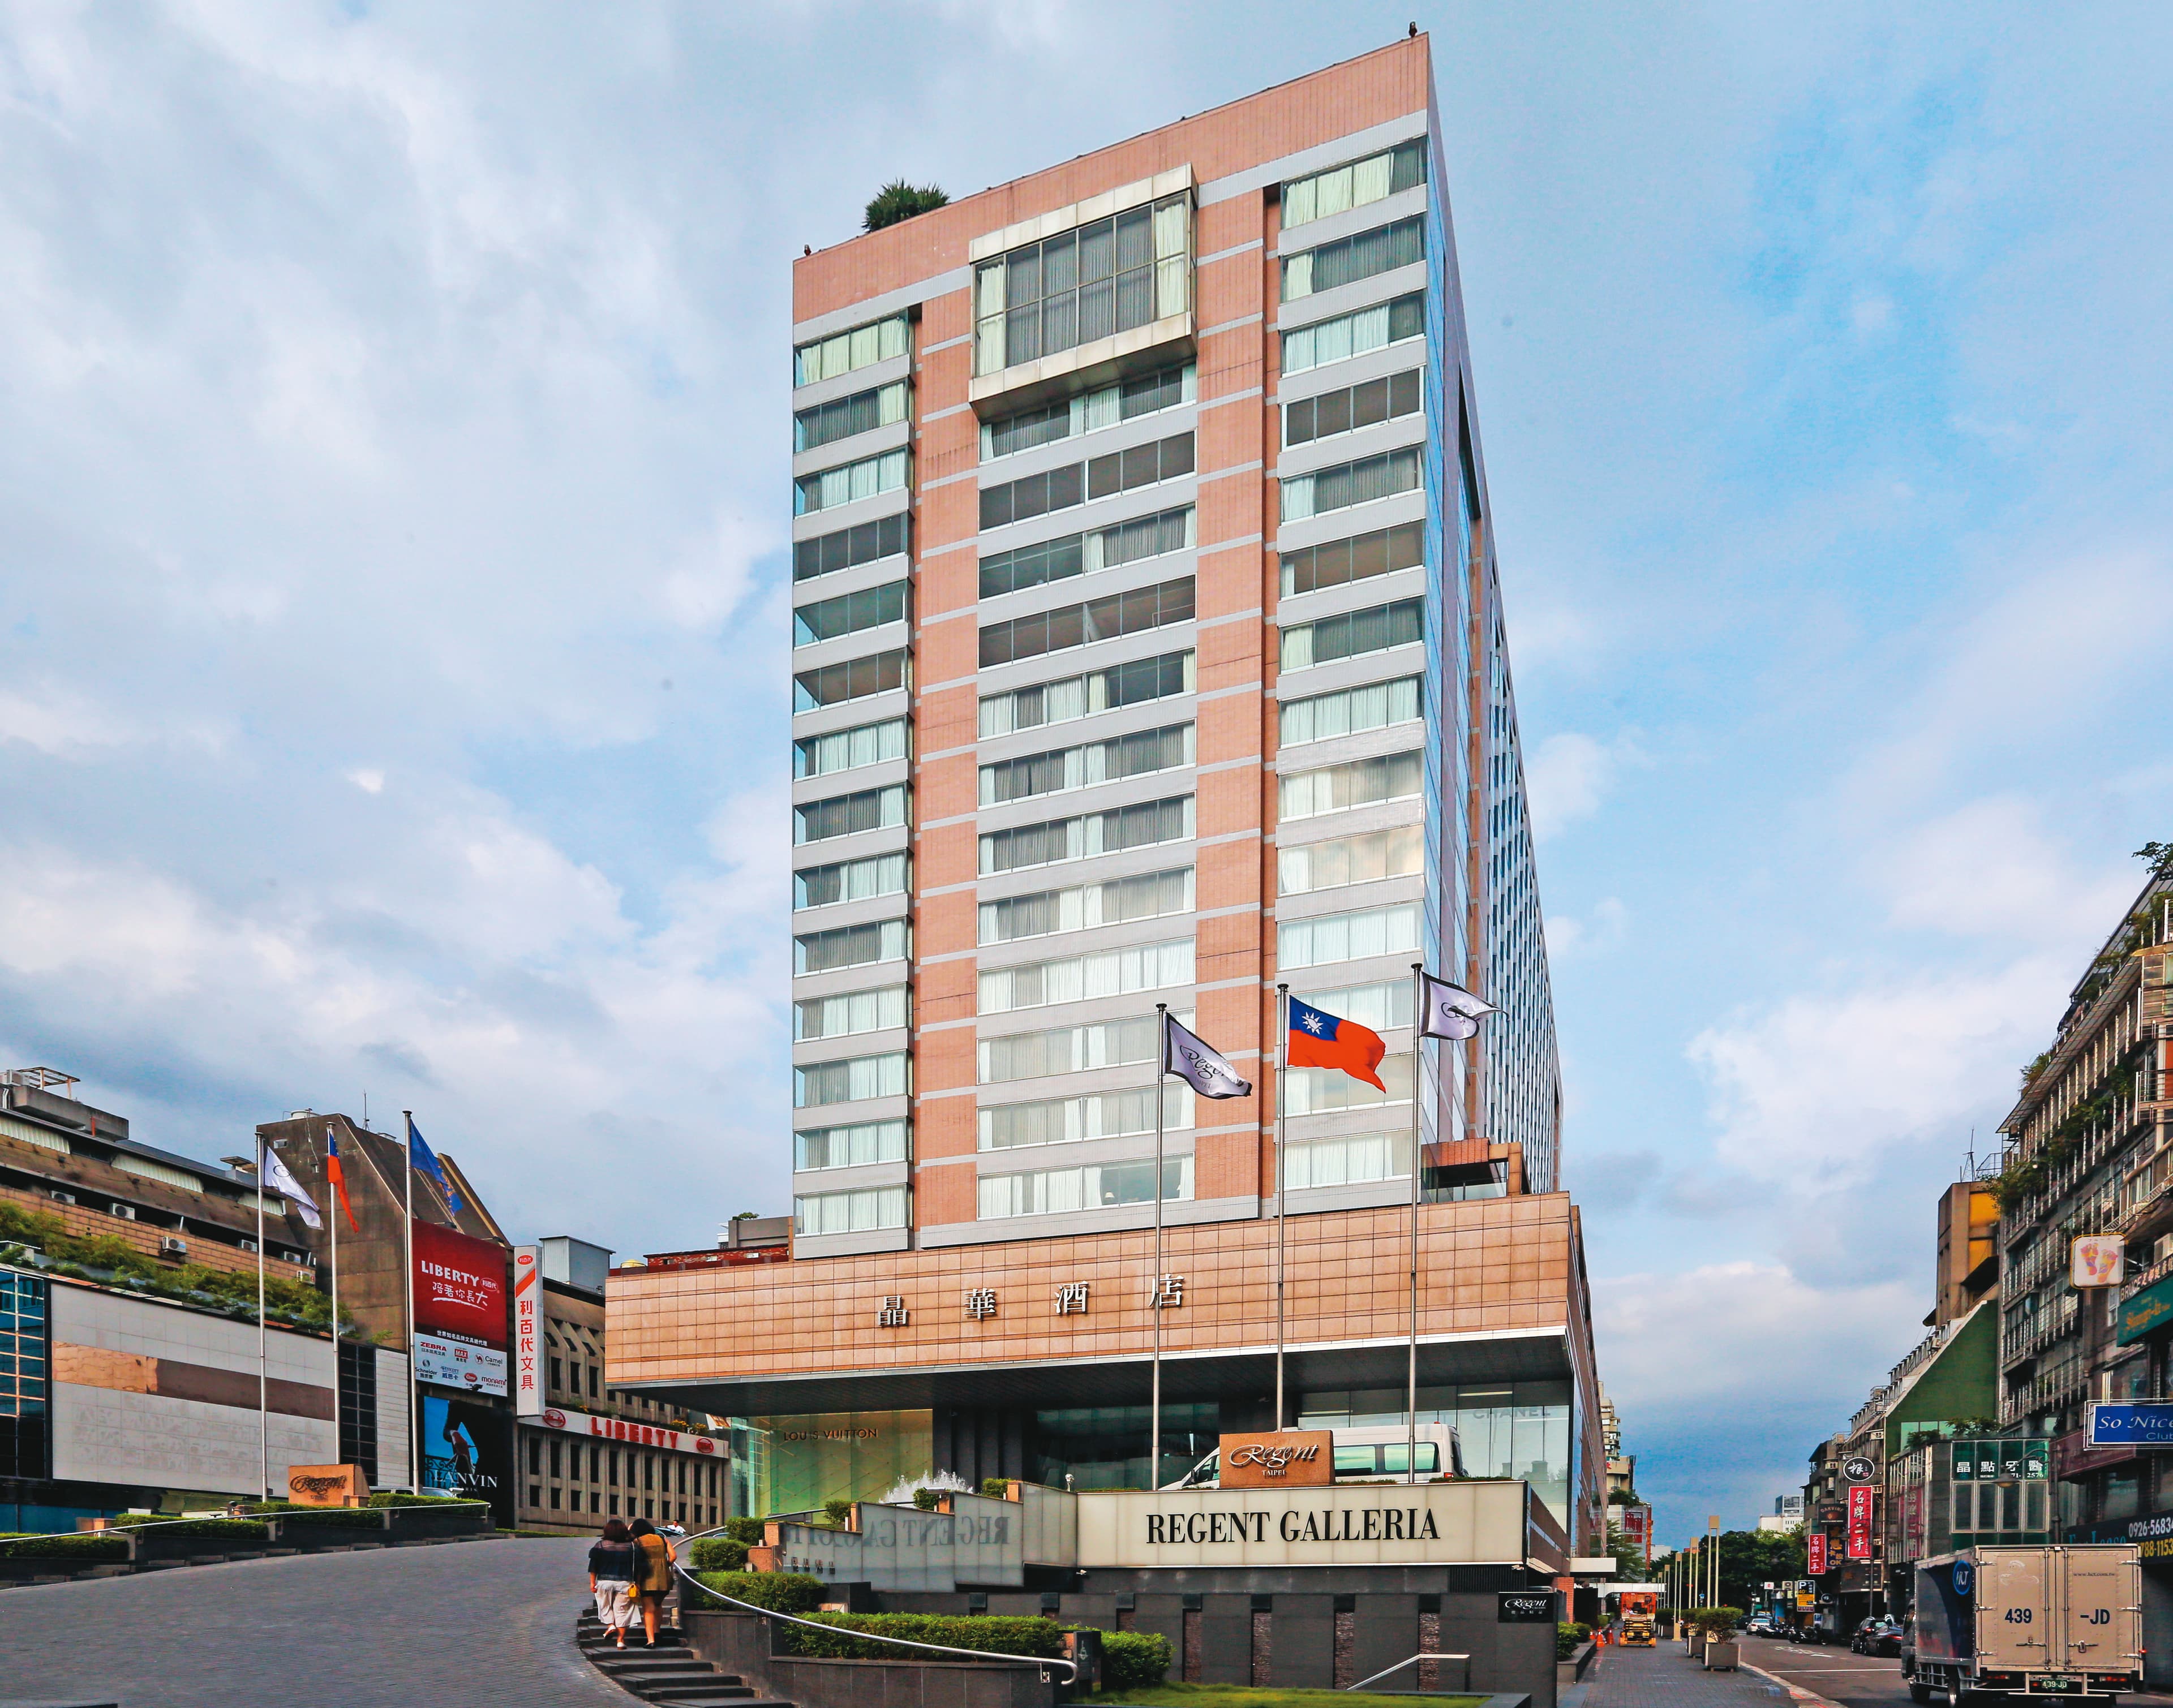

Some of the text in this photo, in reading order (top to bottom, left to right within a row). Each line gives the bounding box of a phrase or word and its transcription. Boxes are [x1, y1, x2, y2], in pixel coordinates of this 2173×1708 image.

[422, 1260, 480, 1287] LIBERTY
[432, 1281, 488, 1306] 陪著你長大
[2120, 1275, 2142, 1302] BRUCE
[878, 1274, 1184, 1327] 晶華酒店
[420, 1342, 446, 1351] ZEBRA
[456, 1349, 467, 1358] MAX
[520, 1301, 534, 1389] 利百代文具
[485, 1356, 503, 1365] Camel
[415, 1367, 438, 1375] Schneider
[1473, 1407, 1551, 1419] CHANEL
[2098, 1416, 2122, 1429] So
[591, 1417, 678, 1449] LIBERTY
[784, 1429, 877, 1441] LOUIS VUITTON
[1229, 1444, 1319, 1468] Regent
[435, 1470, 498, 1488] LANVIN
[1146, 1508, 1441, 1544] REGENT GALLERIA
[1854, 1490, 1865, 1551] 名牌二手
[1810, 1536, 1820, 1571] 名牌二手
[2137, 1538, 2173, 1557] 788-1153
[1505, 1598, 1547, 1610] Regent
[2005, 1608, 2110, 1625] 439 -JD
